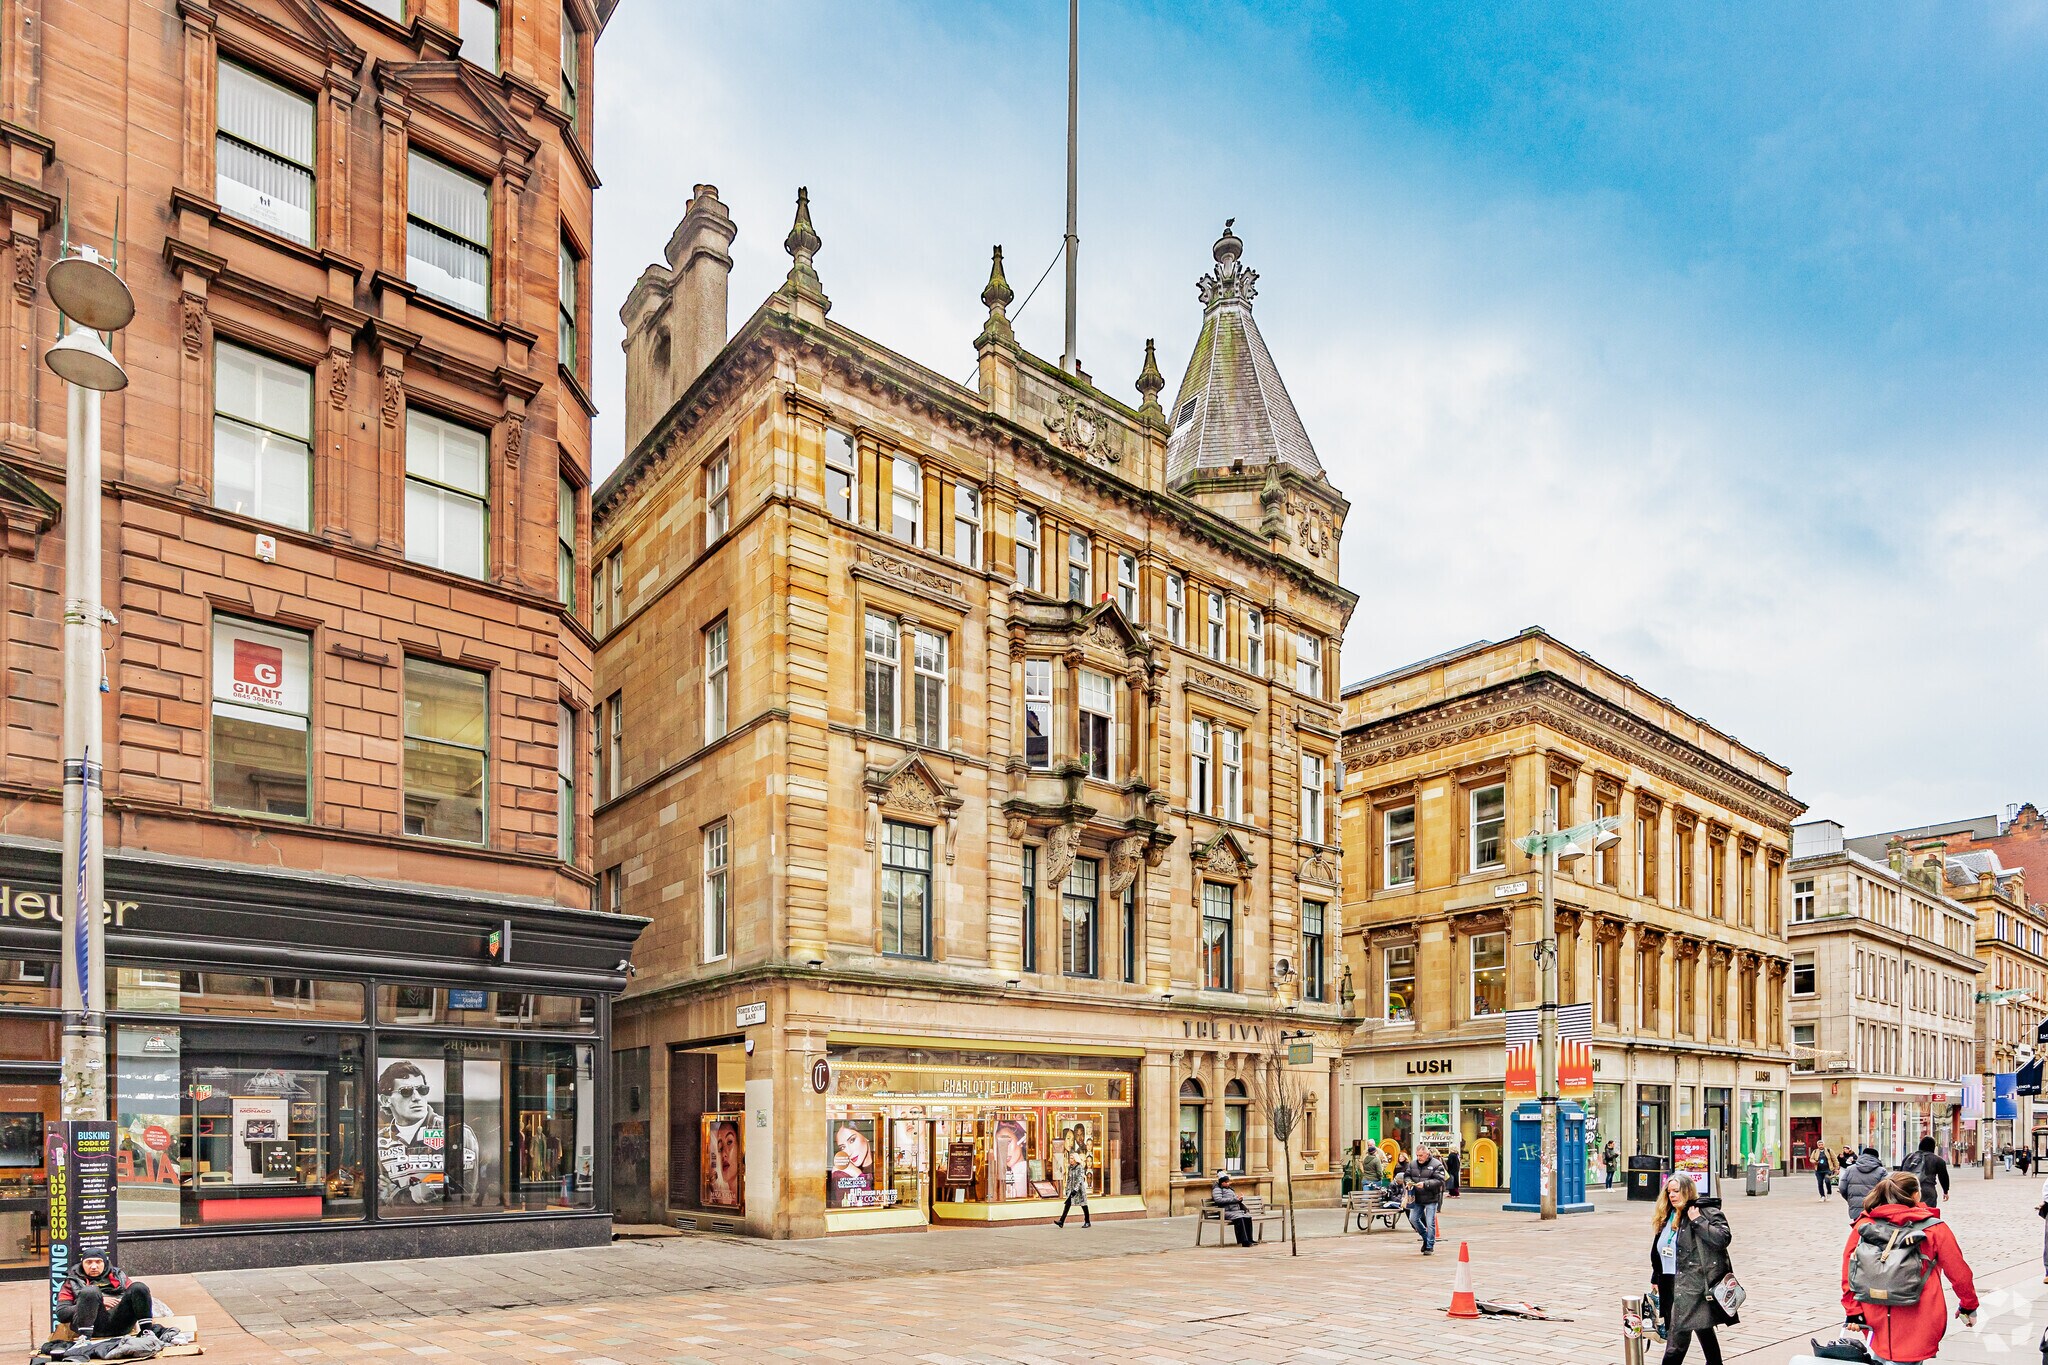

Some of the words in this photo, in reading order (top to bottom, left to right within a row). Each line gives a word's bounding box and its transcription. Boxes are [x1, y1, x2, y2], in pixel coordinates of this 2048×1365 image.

[233, 683, 282, 699] GIANT
[233, 692, 251, 700] 0845
[253, 696, 283, 706] 3096570
[0, 886, 139, 926] eur
[1183, 1020, 1221, 1039] THE
[1230, 1023, 1264, 1041] IVY
[1407, 1059, 1452, 1074] LUSH
[1755, 1070, 1771, 1082] LUSH
[943, 1079, 996, 1094] CHARLOTTE
[997, 1081, 1034, 1095] TILBURY
[78, 1131, 110, 1140] BUSKING
[424, 1138, 444, 1147] HEUE
[380, 1147, 404, 1158] BOSS
[50, 1174, 58, 1196] OF
[57, 1165, 68, 1241] CONDUCT
